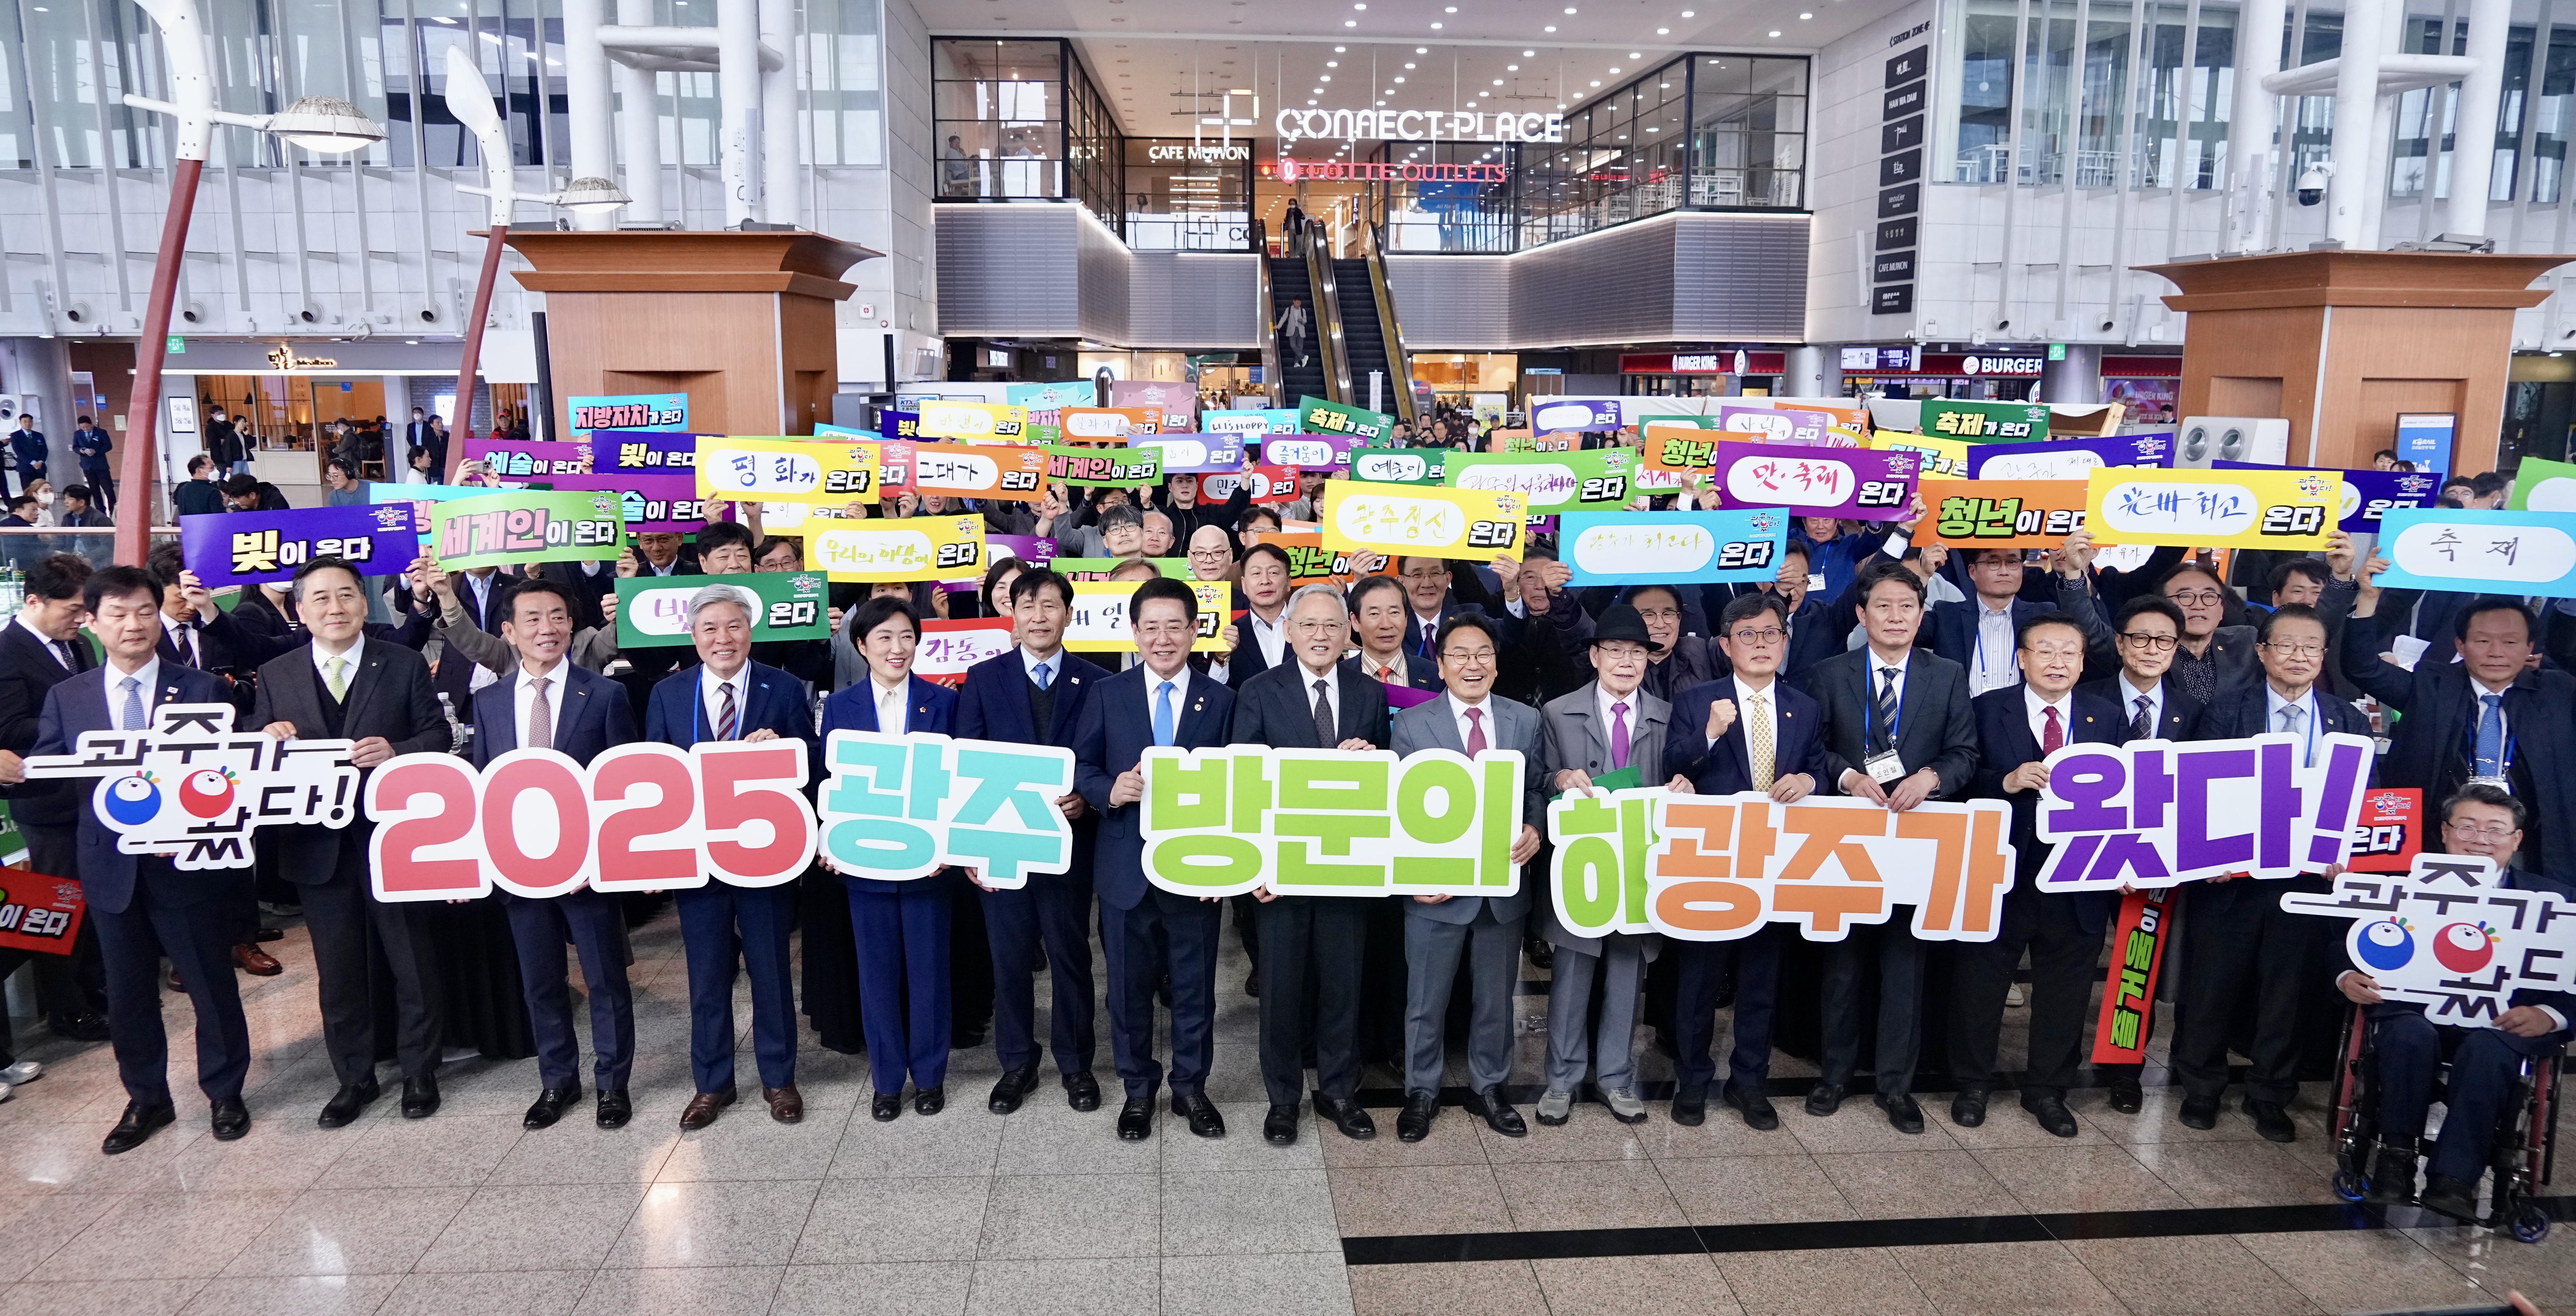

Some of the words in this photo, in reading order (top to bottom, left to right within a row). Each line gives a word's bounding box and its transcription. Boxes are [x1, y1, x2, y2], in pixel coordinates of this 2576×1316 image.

[1893, 29, 1911, 45] STATION
[1912, 23, 1924, 37] ZONE
[1888, 99, 1899, 109] HAN
[1899, 96, 1906, 106] WA
[1907, 92, 1917, 104] DAM
[1276, 108, 1443, 140] CONNECT
[1453, 111, 1564, 143] PLACE
[1149, 146, 1184, 160] CAFE
[1188, 146, 1249, 160] MUWON
[1307, 161, 1395, 181] LOTTE
[1402, 162, 1507, 183] OUTLETS
[1879, 264, 1889, 272] CAFE
[1889, 261, 1908, 272] MUWON
[1678, 355, 1701, 371] BURGER
[1701, 355, 1717, 371] KING
[1982, 357, 2042, 373] BURGER
[2157, 391, 2173, 400] KING
[575, 404, 659, 428] 지방자치가
[661, 410, 682, 424] 온다
[995, 421, 1020, 435] 온다
[1169, 415, 1188, 427] 온다
[1309, 408, 1356, 433] 축제가
[1355, 424, 1380, 438] 온다
[1595, 413, 1616, 424] 온다
[1935, 411, 1998, 435] 축제가
[1999, 422, 2031, 437] 온다
[1272, 424, 1294, 435] 온다
[1794, 427, 1819, 440] 온다
[618, 443, 663, 467] 빛이
[666, 451, 695, 466] 온다
[1168, 446, 1189, 459] 움이
[1210, 450, 1237, 464] 온다
[1279, 445, 1324, 465] 즐거움이
[1504, 437, 1547, 453] 청년이
[484, 451, 549, 475] 예술이
[552, 460, 582, 475] 온다
[918, 461, 978, 482] 그대가
[1047, 455, 1124, 480] 세계인이
[1128, 464, 1155, 478] 온다
[1951, 460, 1968, 478] 온
[825, 470, 868, 492] 온다
[1001, 471, 1038, 489] 온다
[1272, 483, 1294, 495] 온다
[1581, 477, 1624, 501] 온다
[1858, 481, 1905, 505] 온다
[621, 490, 666, 522] 술이
[1937, 497, 2041, 537] 청년이
[1352, 503, 1447, 539] 광주정신
[2262, 505, 2321, 533] 온다
[439, 509, 568, 557] 세계인이
[575, 521, 615, 543] 온다
[1469, 521, 1514, 546] 온다
[231, 529, 307, 572] 빛이
[315, 536, 372, 560] 온다
[826, 539, 874, 563] 우리의
[938, 542, 977, 566] 온다
[1284, 546, 1349, 577] 청년이
[1719, 542, 1770, 566] 온다
[769, 601, 816, 626] 온다
[1198, 612, 1216, 635] 다
[925, 637, 1001, 663] 감동이
[372, 748, 807, 894] 2025
[827, 739, 1067, 880] 광주
[1150, 755, 1515, 888] 방문의
[1655, 803, 2008, 933] 광주가
[2047, 742, 2364, 882] 왔다!
[21, 908, 70, 935] 온다
[2110, 907, 2160, 1050] 즐거움이
